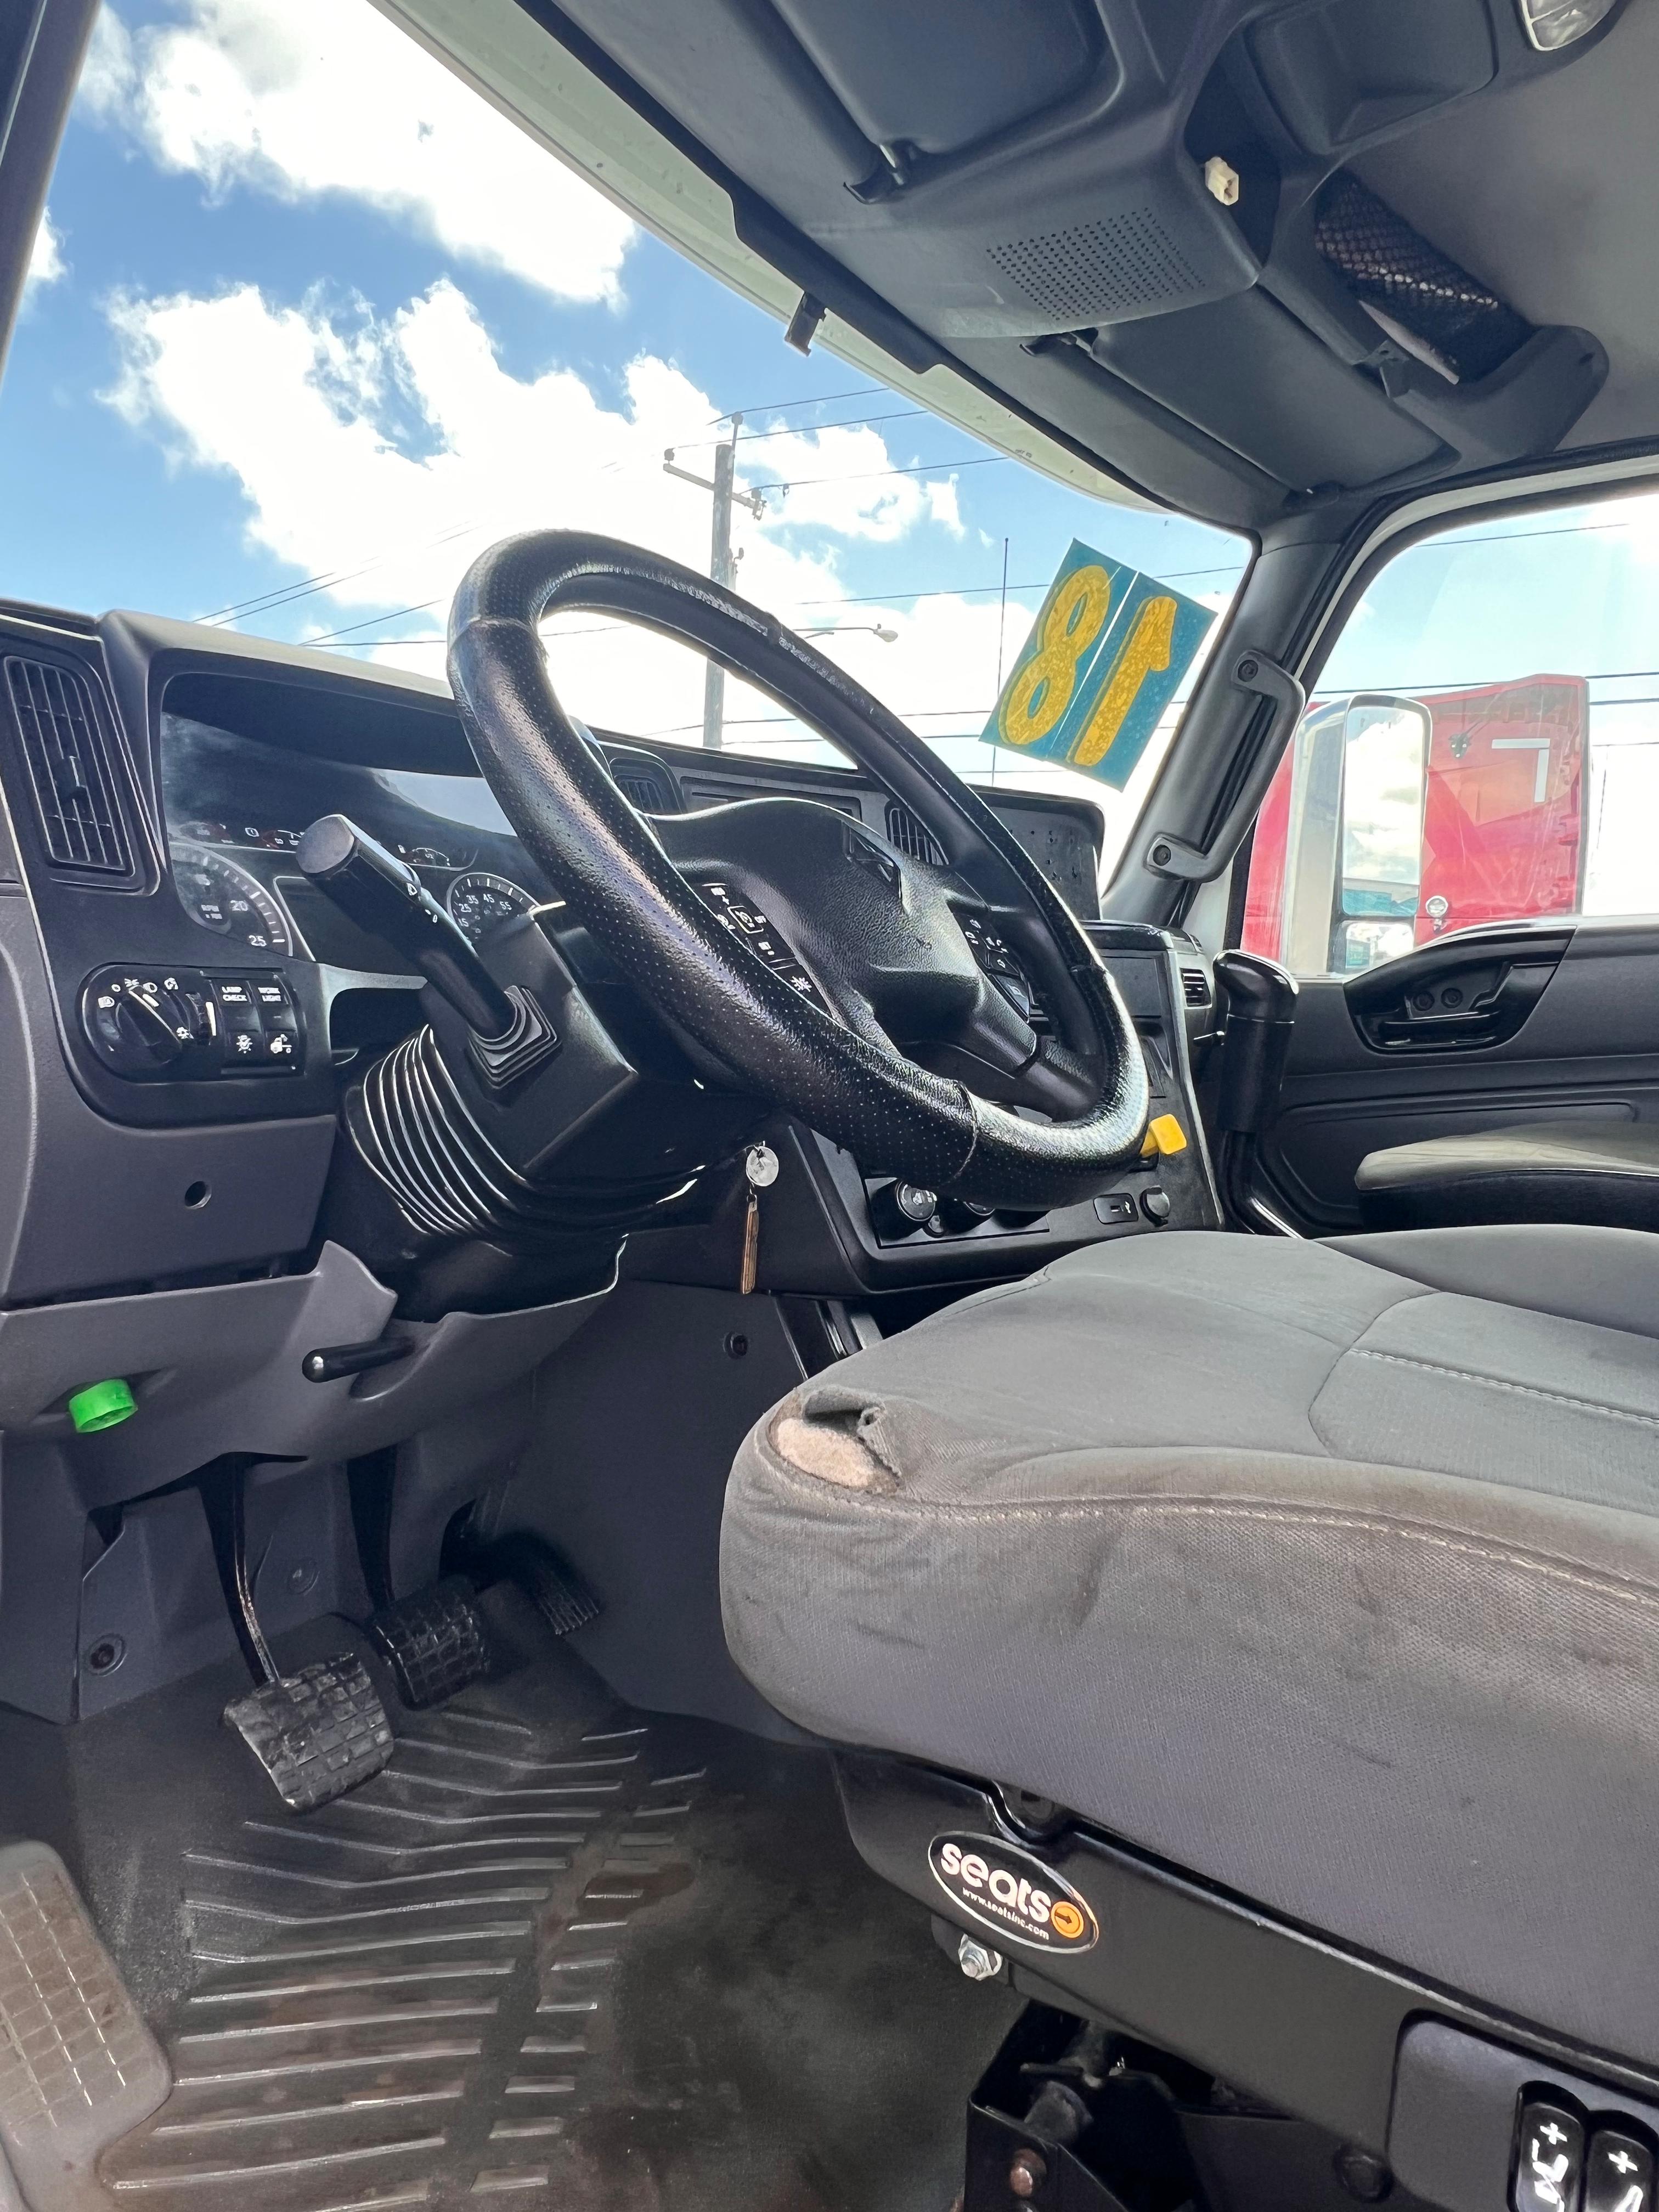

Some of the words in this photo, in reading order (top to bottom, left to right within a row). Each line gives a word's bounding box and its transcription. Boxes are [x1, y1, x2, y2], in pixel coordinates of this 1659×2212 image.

[466, 895, 479, 904] 35
[483, 894, 495, 903] 45
[229, 900, 249, 911] 20
[458, 904, 472, 912] 25
[499, 901, 512, 910] 55
[458, 918, 469, 927] 15
[248, 935, 267, 947] 25
[940, 1843, 1052, 1923] seats
